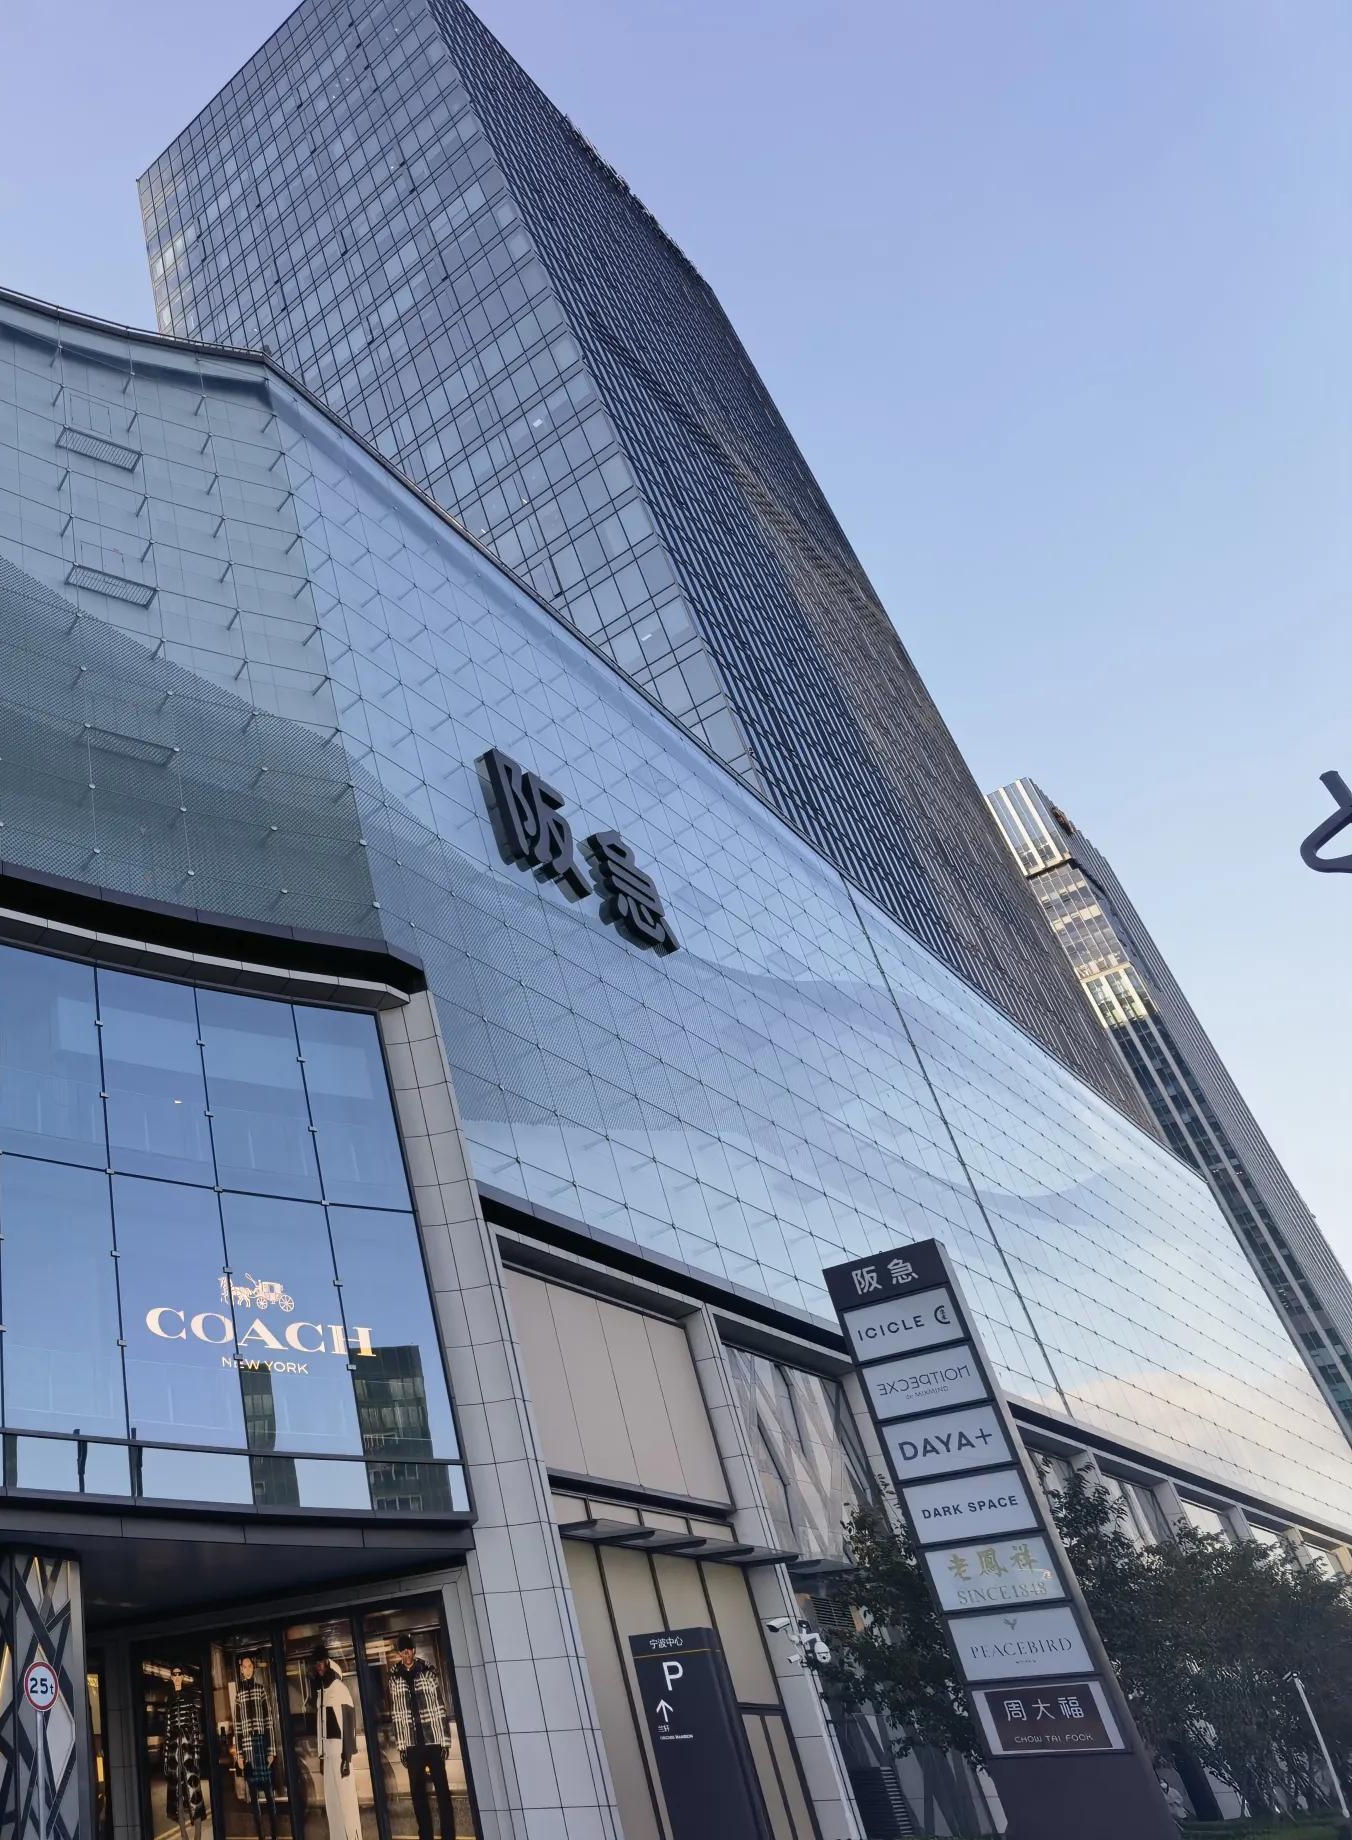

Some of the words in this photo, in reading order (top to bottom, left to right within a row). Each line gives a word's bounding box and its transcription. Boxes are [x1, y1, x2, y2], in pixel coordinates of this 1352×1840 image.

[474, 748, 681, 958] 阪急
[851, 1258, 919, 1295] 阪急
[145, 1307, 377, 1357] COACH
[857, 1315, 925, 1341] ICICLE
[264, 1359, 309, 1375] YORK
[898, 1428, 993, 1461] DAYA+
[921, 1504, 963, 1519] DARK
[967, 1495, 1019, 1513] SPACE
[948, 1543, 1039, 1581] 老鳳祥
[649, 1636, 683, 1649] 宁波中心
[969, 1637, 1072, 1659] PEACEBIRD
[30, 1677, 54, 1695] 25t
[662, 1661, 684, 1691] P
[1003, 1696, 1085, 1722] 周大福
[1014, 1735, 1043, 1744] CHOW
[1045, 1735, 1061, 1743] TAI
[1065, 1733, 1094, 1743] FOOK
